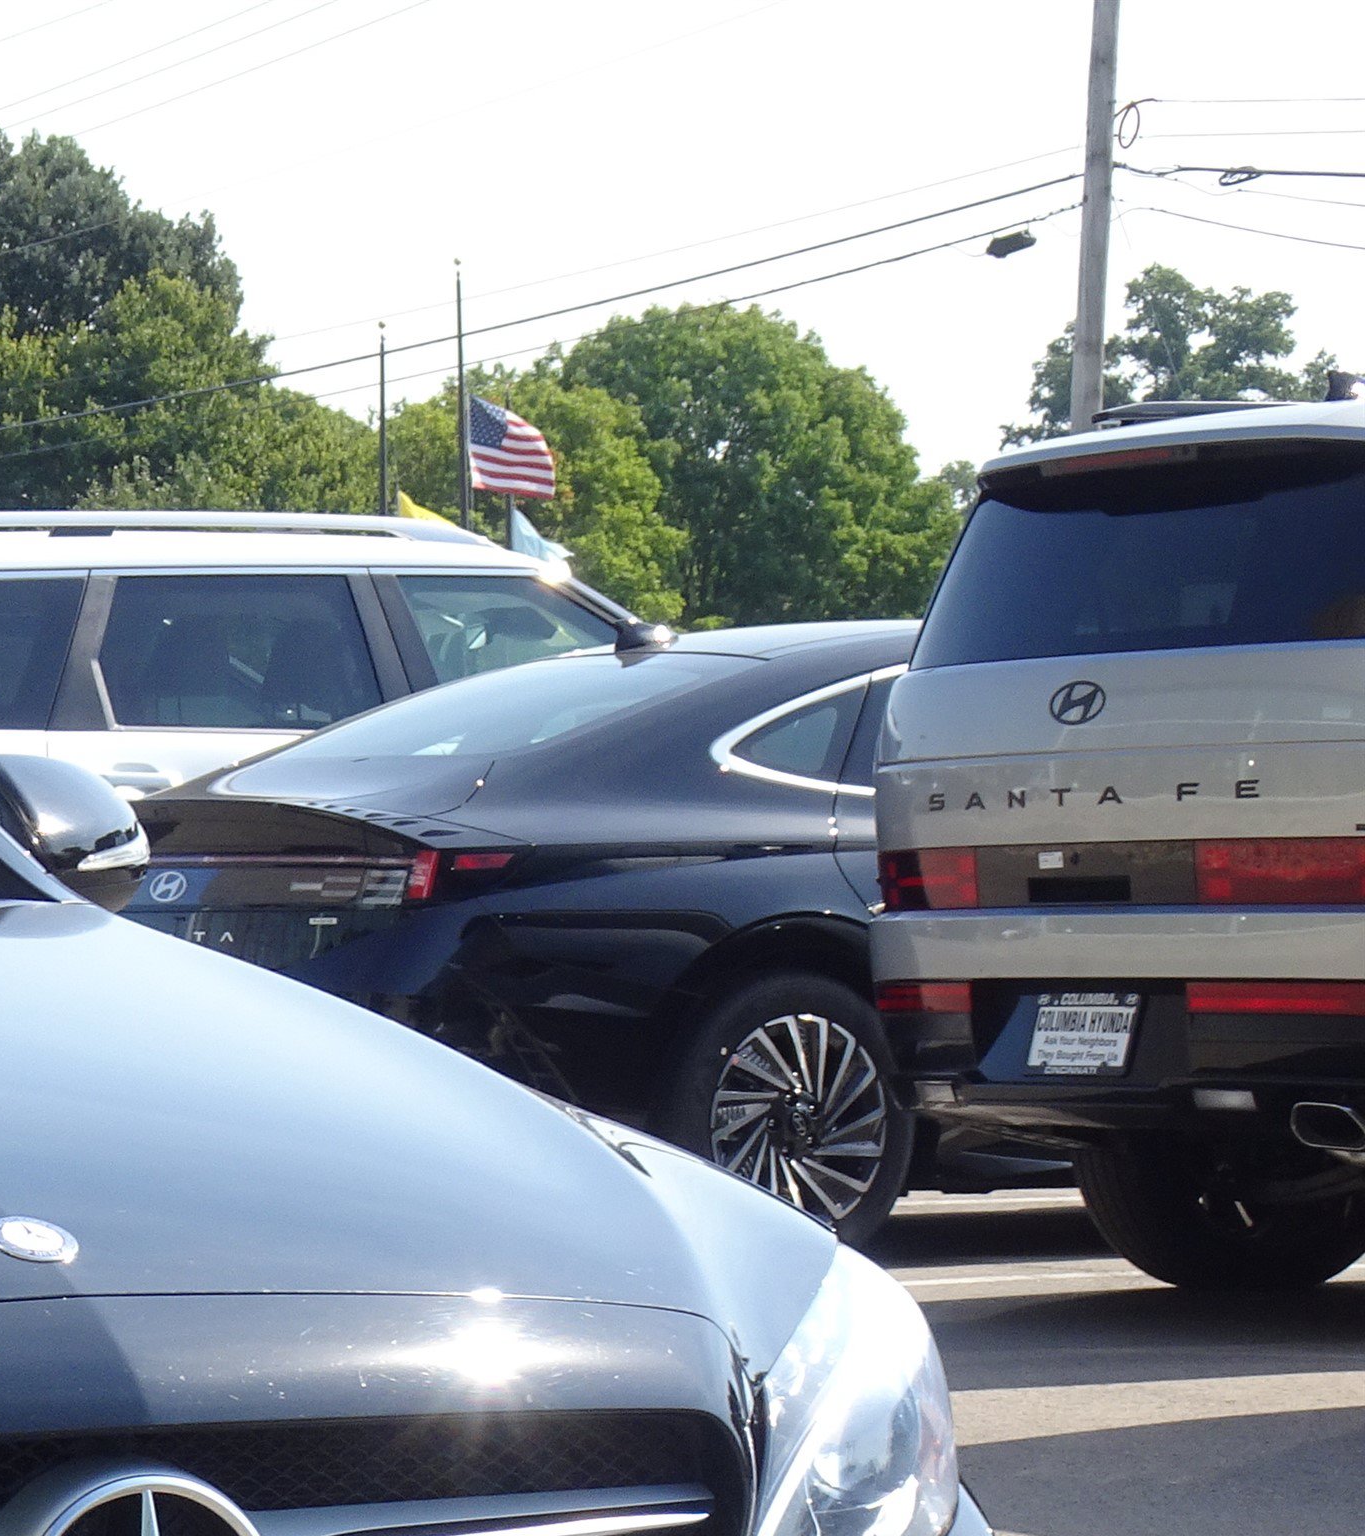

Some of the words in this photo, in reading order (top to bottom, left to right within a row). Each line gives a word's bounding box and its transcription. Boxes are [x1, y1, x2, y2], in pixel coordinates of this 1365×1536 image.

[928, 786, 1123, 813] SANTA
[1176, 779, 1261, 801] FE
[1060, 993, 1115, 1005] COLUMBIA
[1037, 1011, 1087, 1032] COLUMBIA
[1087, 1011, 1130, 1033] HYUNDA
[1044, 1036, 1057, 1045] Ask
[1059, 1036, 1075, 1045] Your
[1077, 1037, 1117, 1048] Neighbors
[1037, 1050, 1054, 1060] They
[1056, 1050, 1083, 1061] Bought
[1084, 1051, 1105, 1060] From
